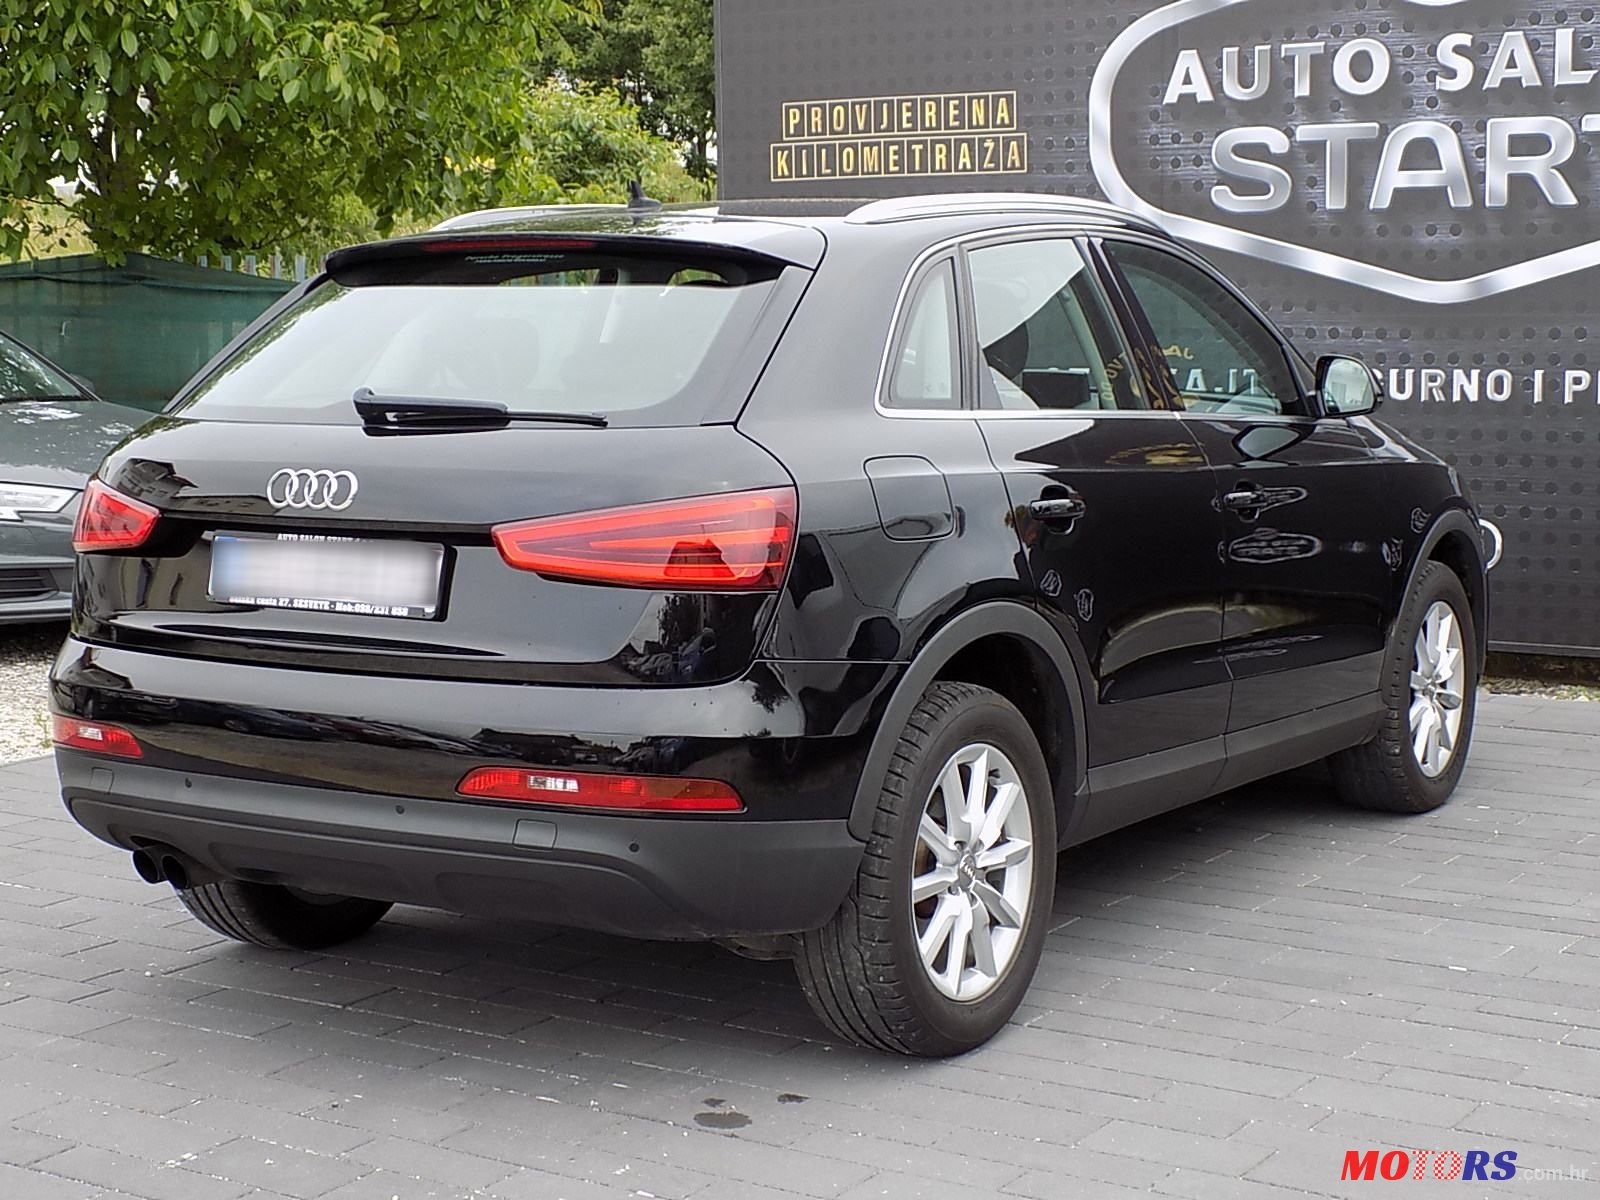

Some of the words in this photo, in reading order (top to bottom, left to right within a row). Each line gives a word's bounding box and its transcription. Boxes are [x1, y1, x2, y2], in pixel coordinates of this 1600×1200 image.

[1162, 37, 1391, 105] AUTO
[1435, 28, 1598, 91] SAL
[788, 97, 1011, 135] PROVJERENA
[776, 138, 1021, 177] KILOMETRAŽA
[1210, 113, 1600, 213] STAR
[1533, 369, 1545, 404] I
[1563, 369, 1600, 405] P
[277, 533, 298, 542] AUTO
[299, 534, 326, 544] SALON
